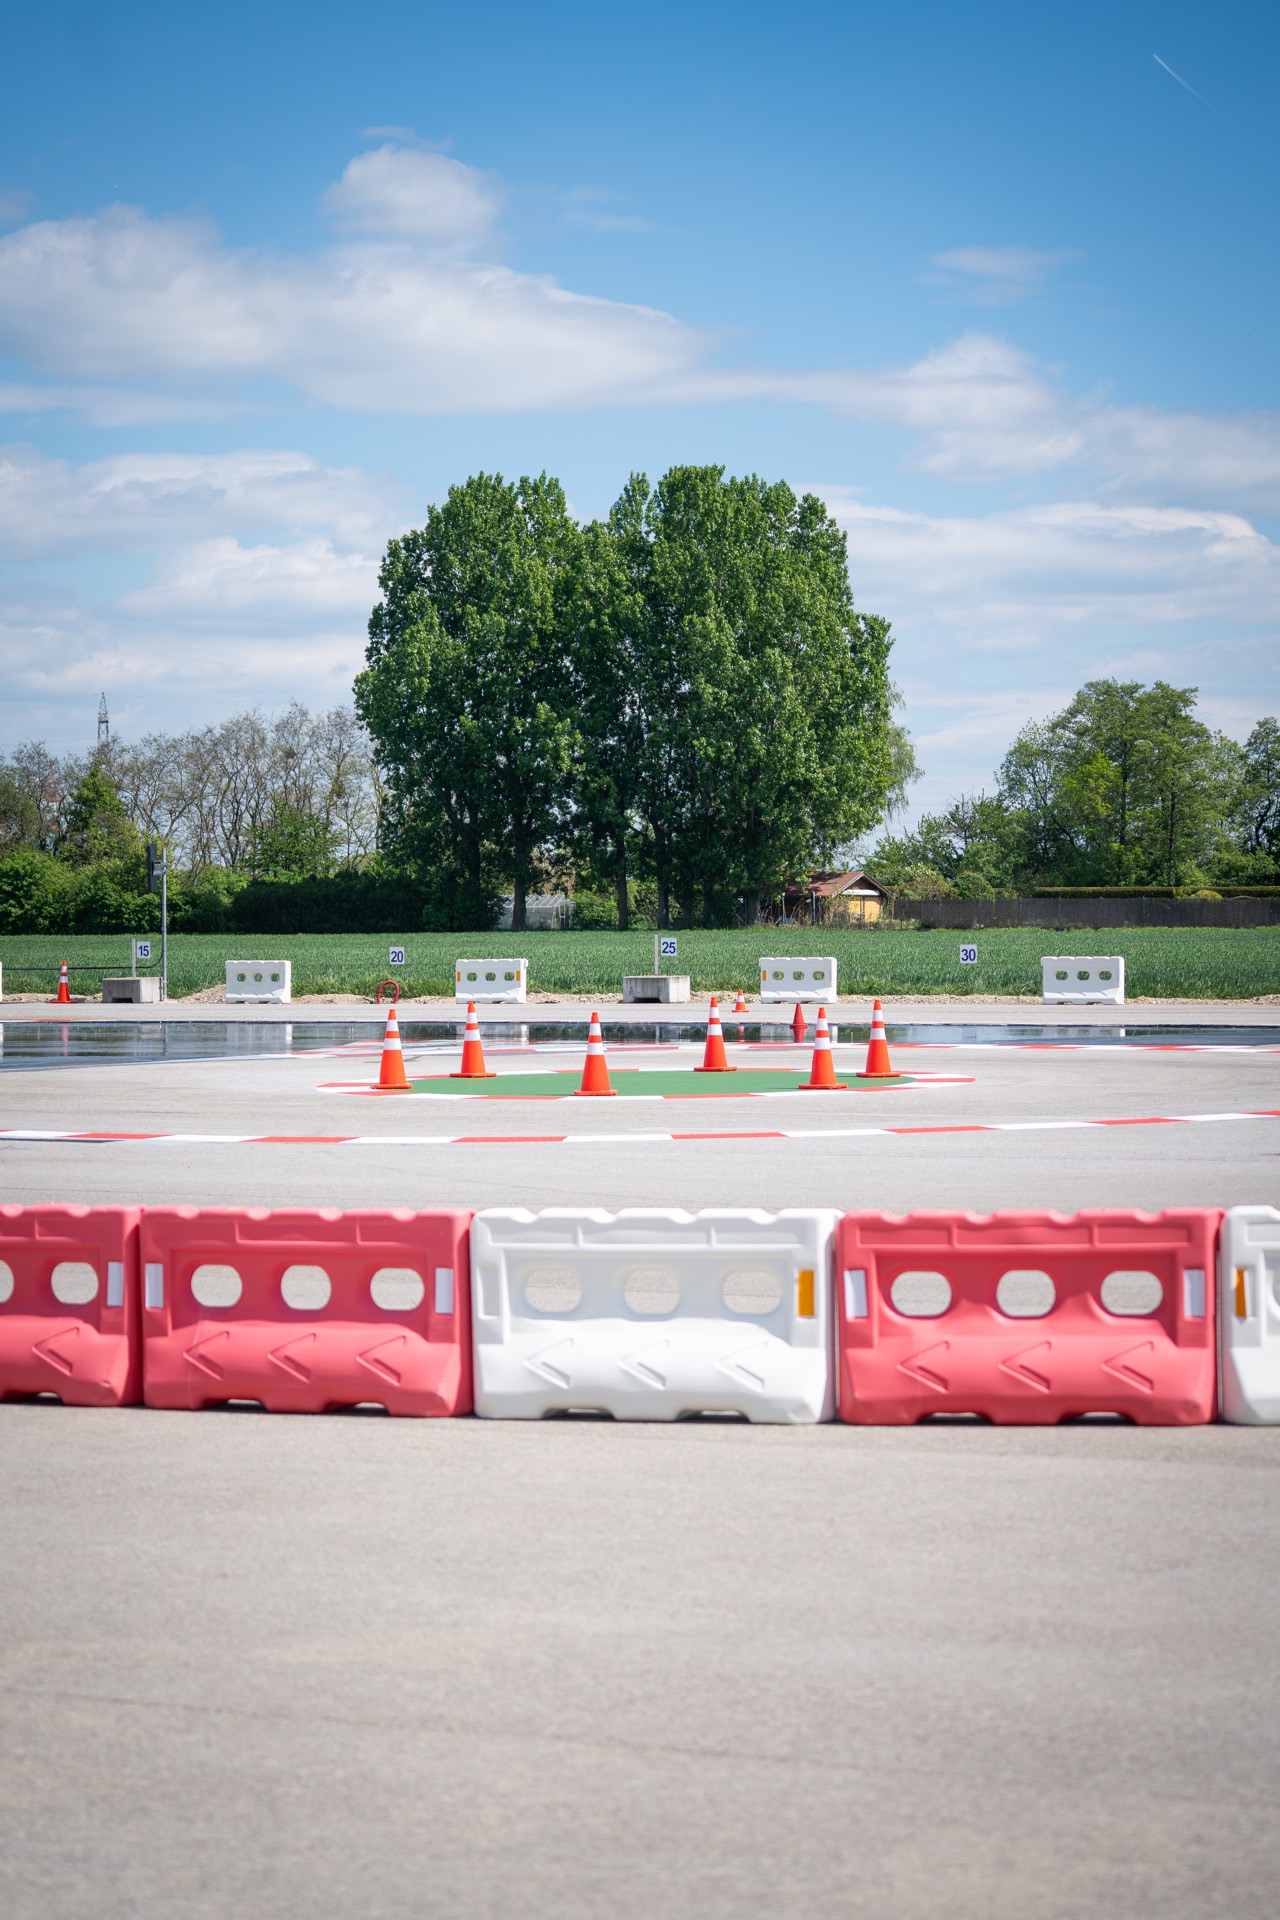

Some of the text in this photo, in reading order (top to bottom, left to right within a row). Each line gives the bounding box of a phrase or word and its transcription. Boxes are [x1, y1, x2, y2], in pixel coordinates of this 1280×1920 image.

[138, 945, 150, 957] 15
[662, 942, 676, 954] 25
[390, 950, 404, 963] 20
[961, 948, 977, 961] 30
